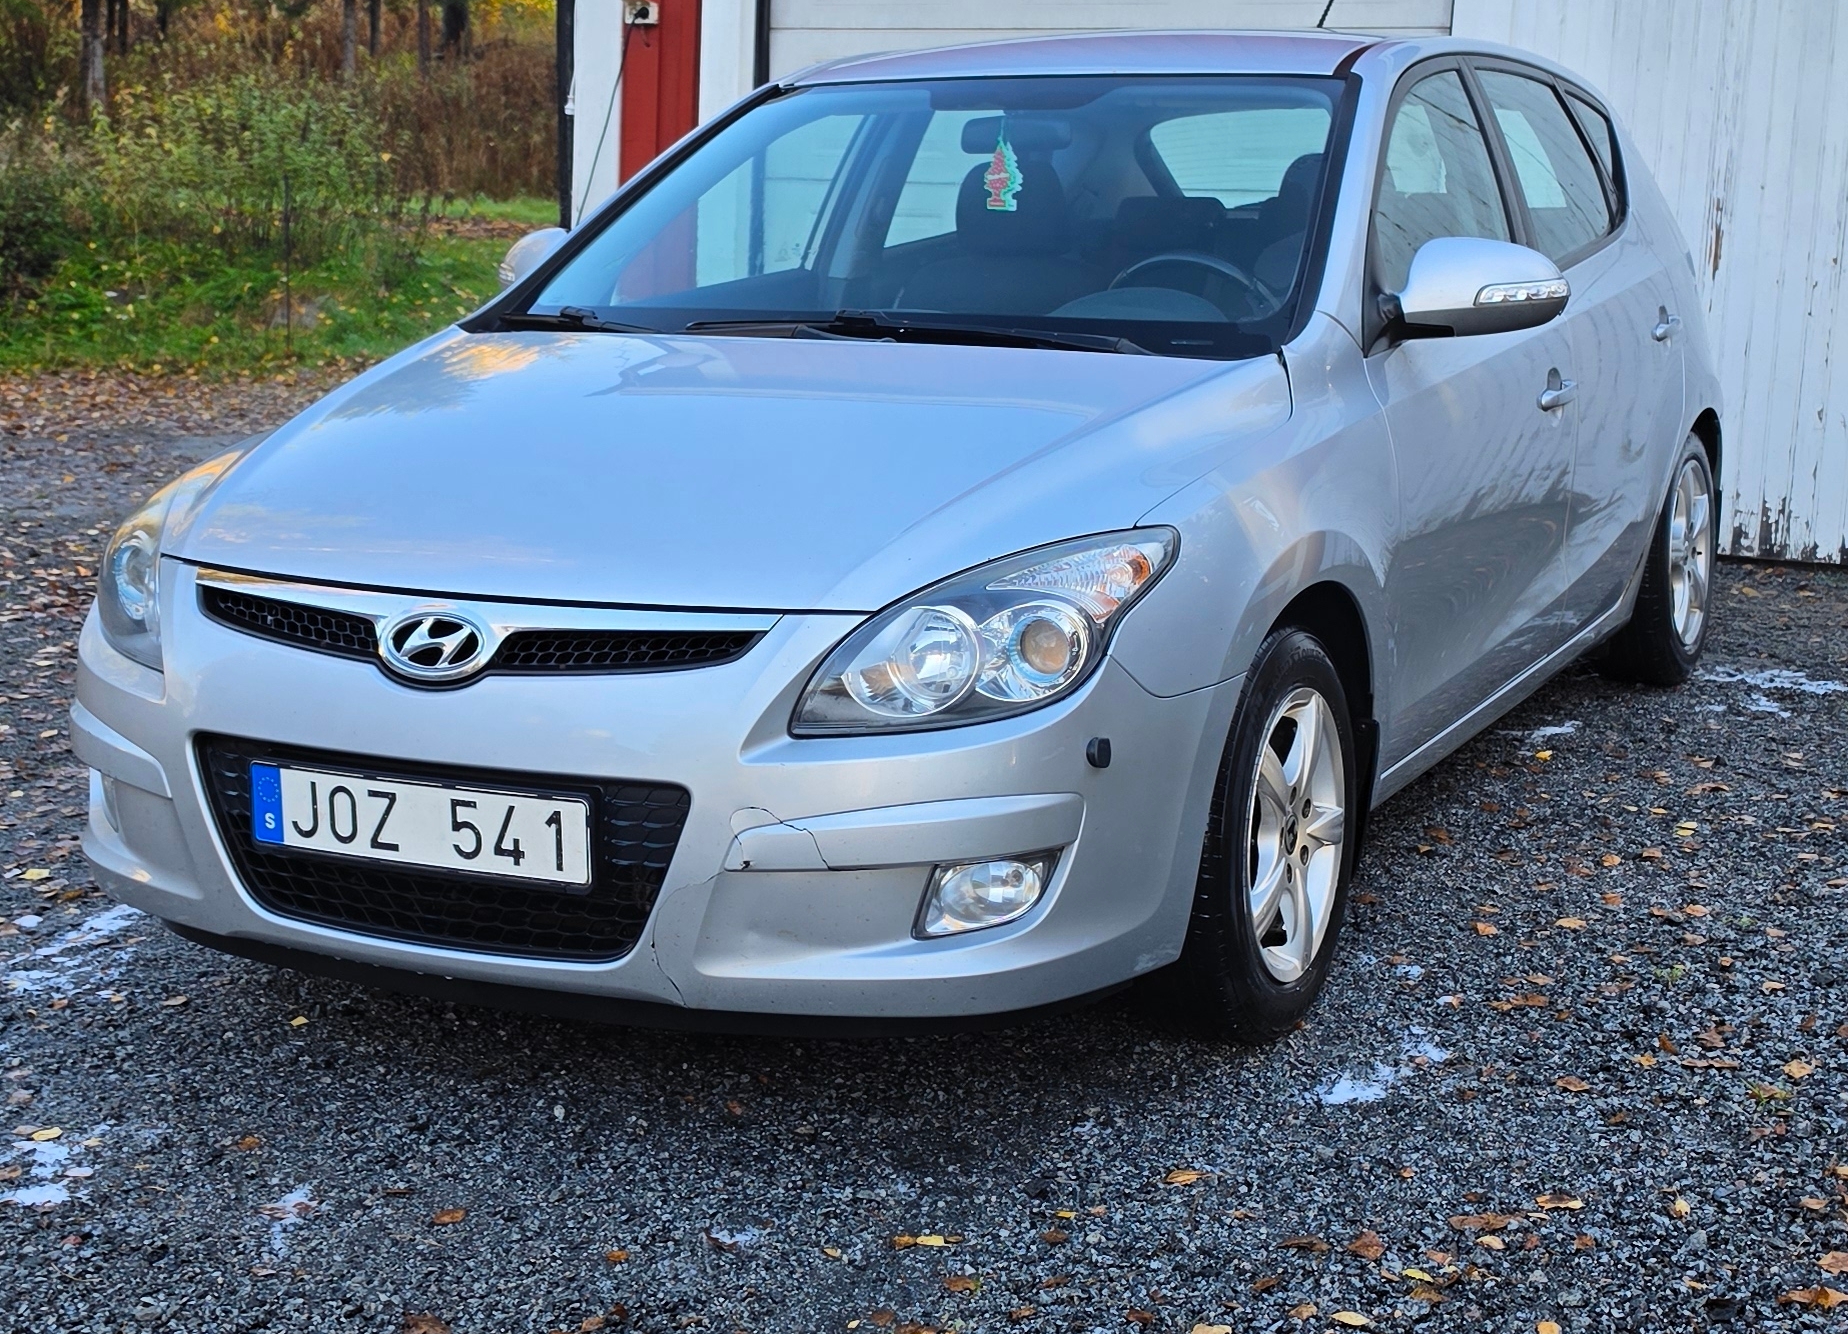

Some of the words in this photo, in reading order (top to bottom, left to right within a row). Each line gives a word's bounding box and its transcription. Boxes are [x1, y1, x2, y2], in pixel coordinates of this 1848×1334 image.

[265, 812, 276, 830] S
[291, 781, 400, 852] JOZ
[450, 798, 564, 872] 541
